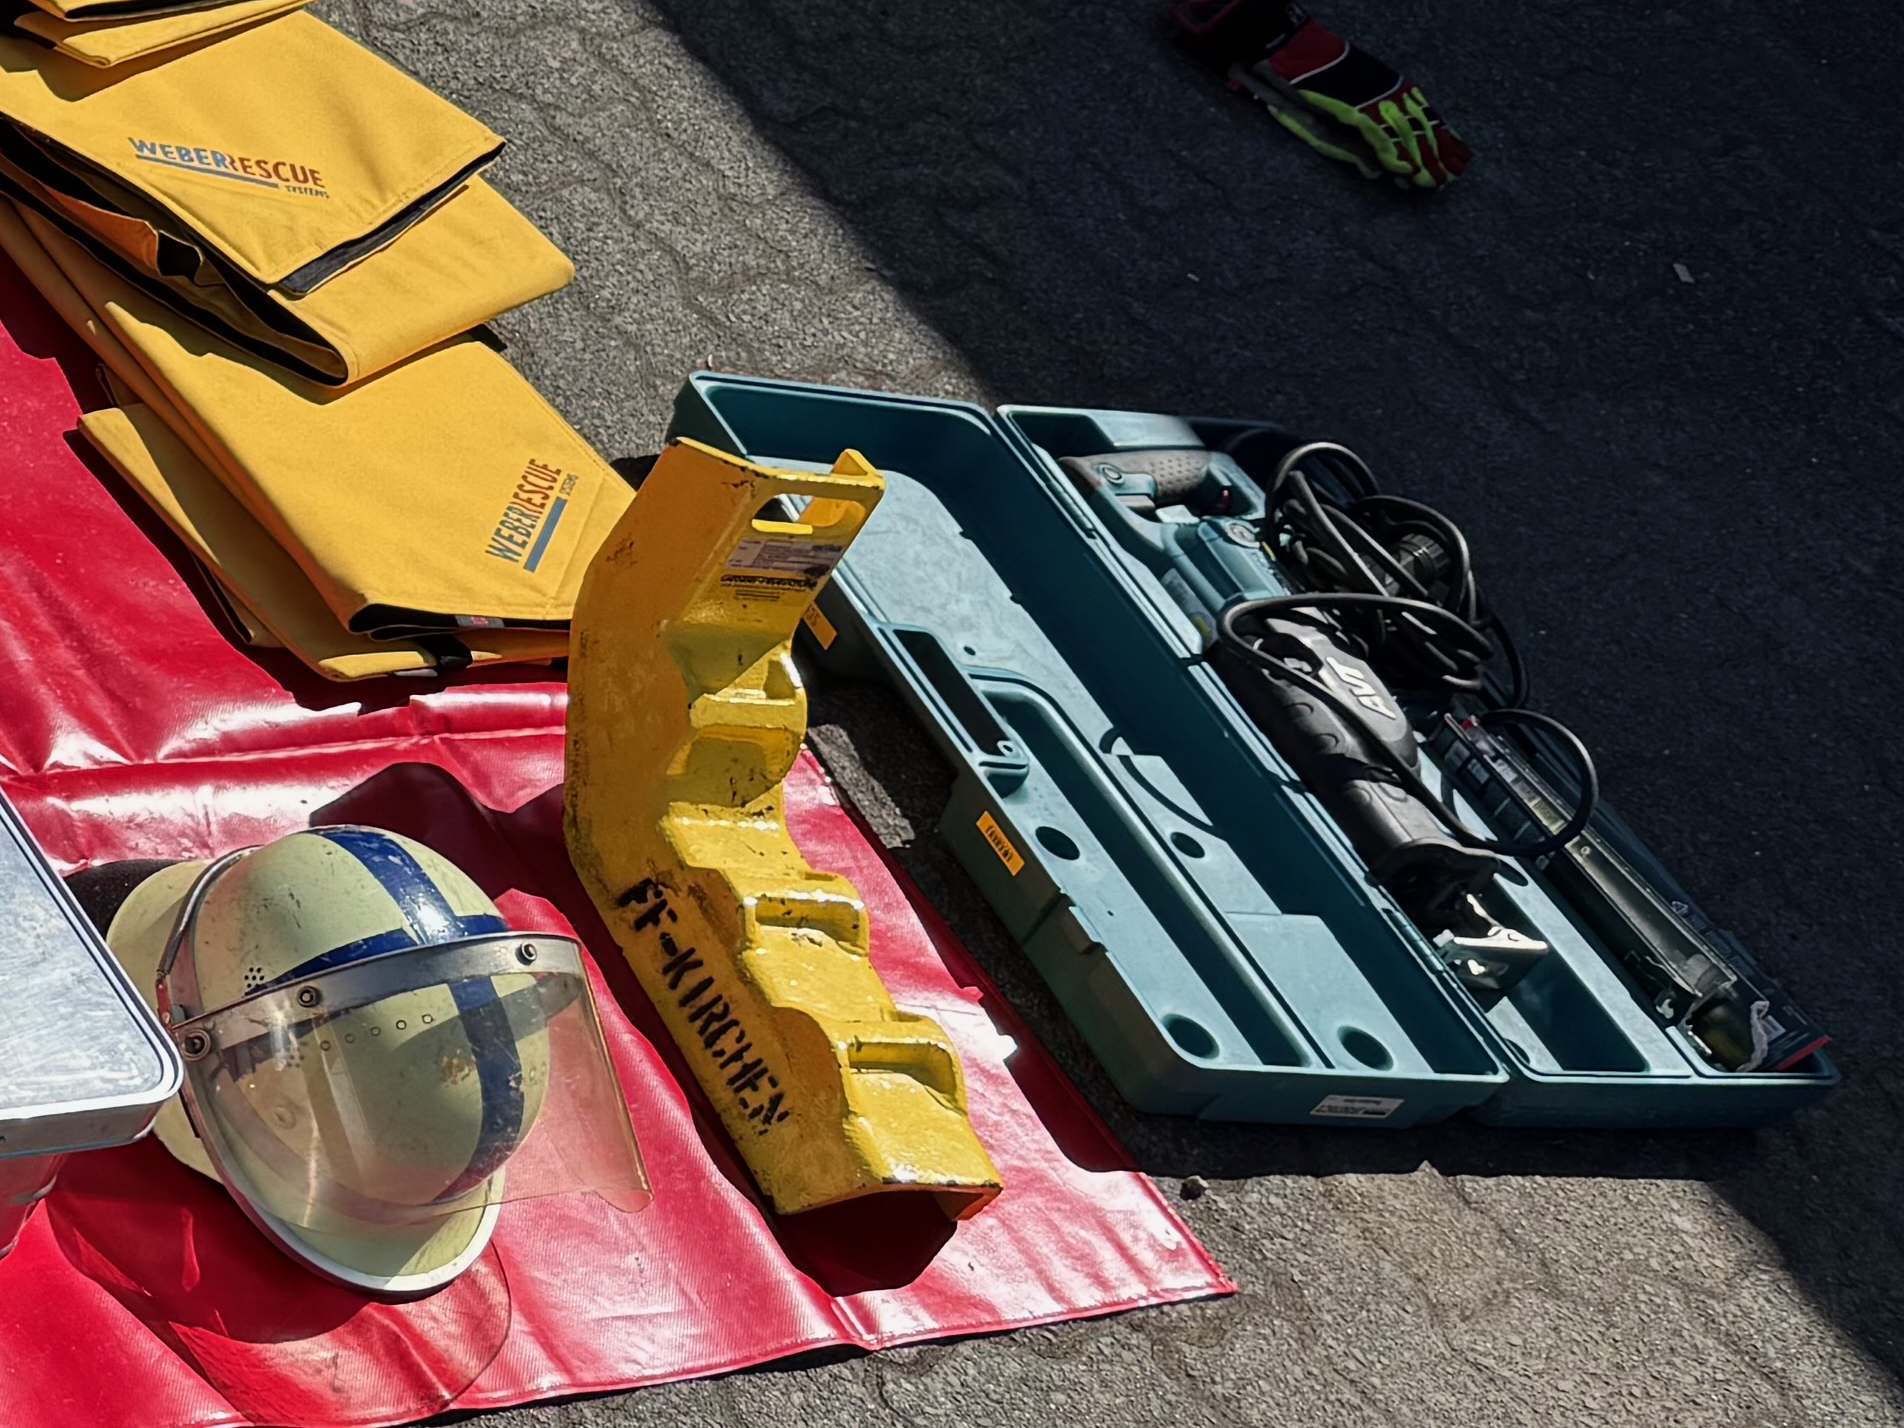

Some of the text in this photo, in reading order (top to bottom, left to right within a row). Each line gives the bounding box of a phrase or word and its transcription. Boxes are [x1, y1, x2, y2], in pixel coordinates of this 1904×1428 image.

[128, 137, 327, 190] WEBERRESCUE
[285, 184, 331, 200] SYSTEMS
[484, 458, 563, 564] WEBERRESCUE
[615, 877, 791, 1134] FF-KIRCHEN
